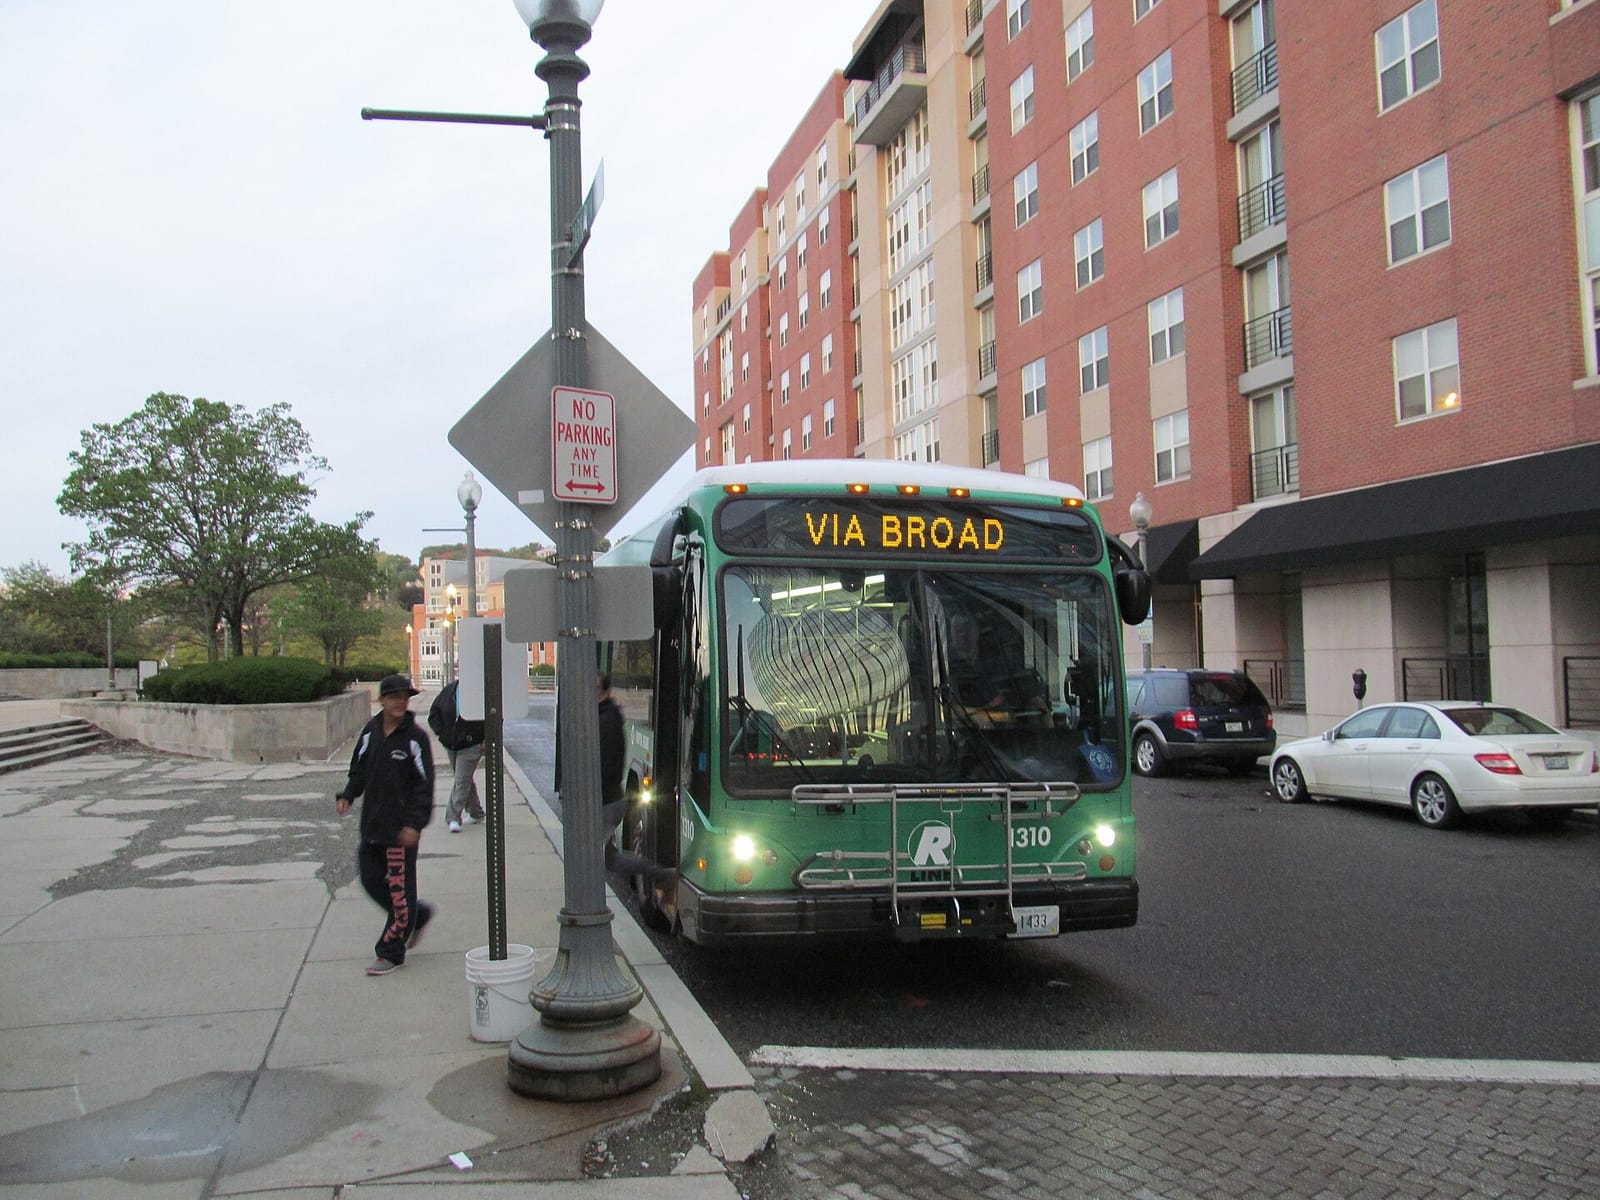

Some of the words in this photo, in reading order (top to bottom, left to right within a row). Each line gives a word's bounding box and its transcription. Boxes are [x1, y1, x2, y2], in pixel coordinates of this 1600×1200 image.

[572, 399, 596, 421] NO
[557, 421, 611, 447] PARKING
[573, 447, 597, 462] ANY
[570, 463, 600, 479] TIME
[805, 512, 865, 547] VIA
[882, 515, 1004, 550] BROAD
[913, 826, 951, 865] R
[1020, 913, 1048, 929] 1433
